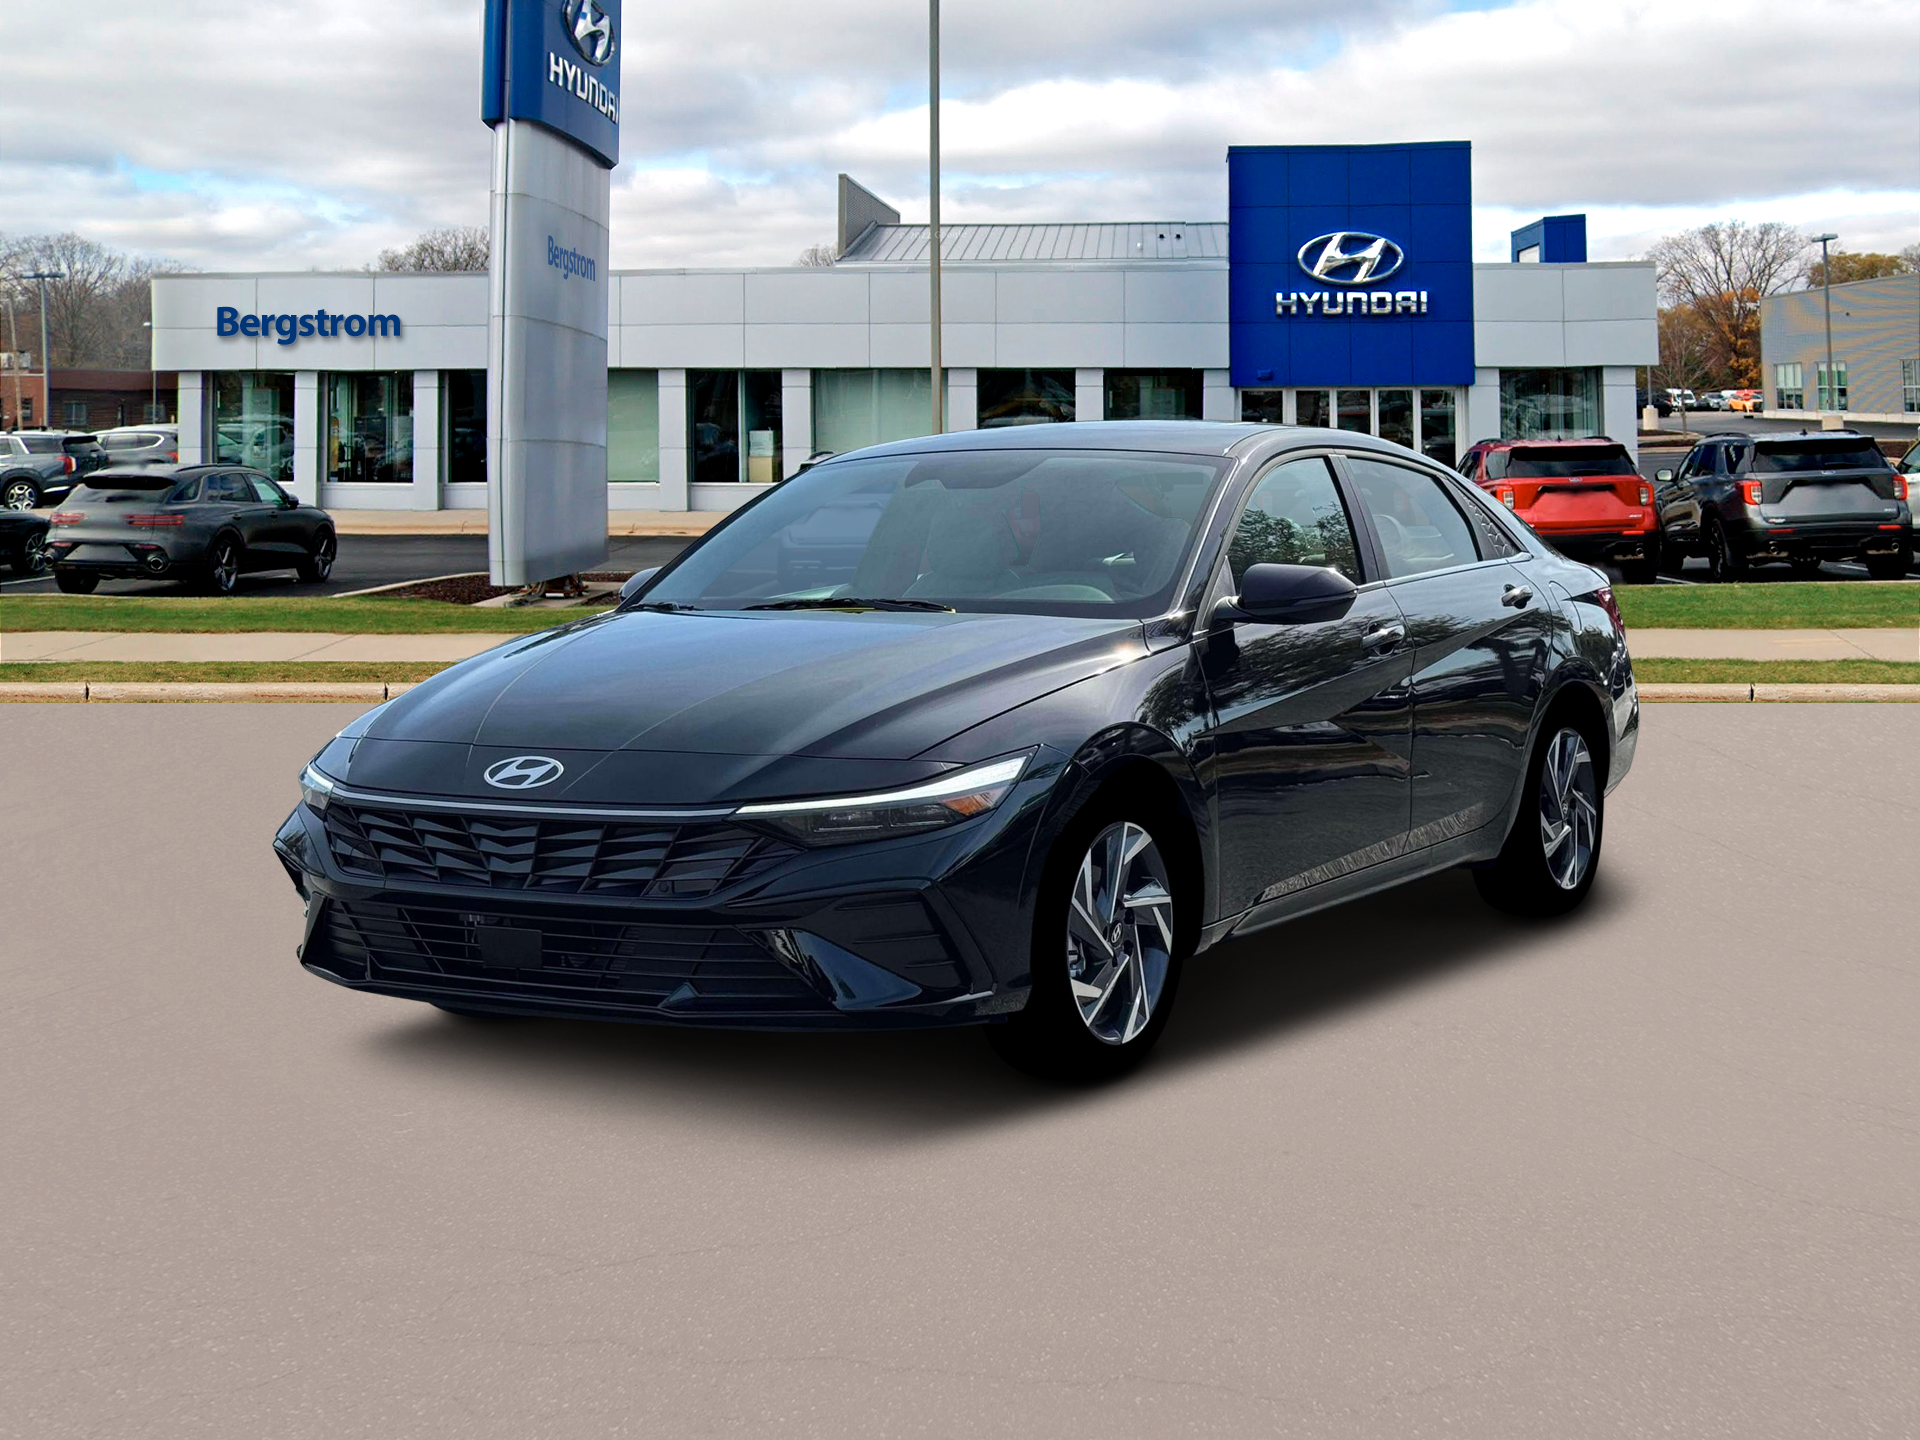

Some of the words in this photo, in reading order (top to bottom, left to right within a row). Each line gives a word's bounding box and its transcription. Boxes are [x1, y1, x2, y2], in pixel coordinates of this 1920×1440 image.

[549, 51, 619, 124] HYUNDAI
[547, 235, 596, 282] Bergstrom
[1275, 291, 1428, 316] HYUNDAI
[216, 306, 401, 346] Bergstrom
